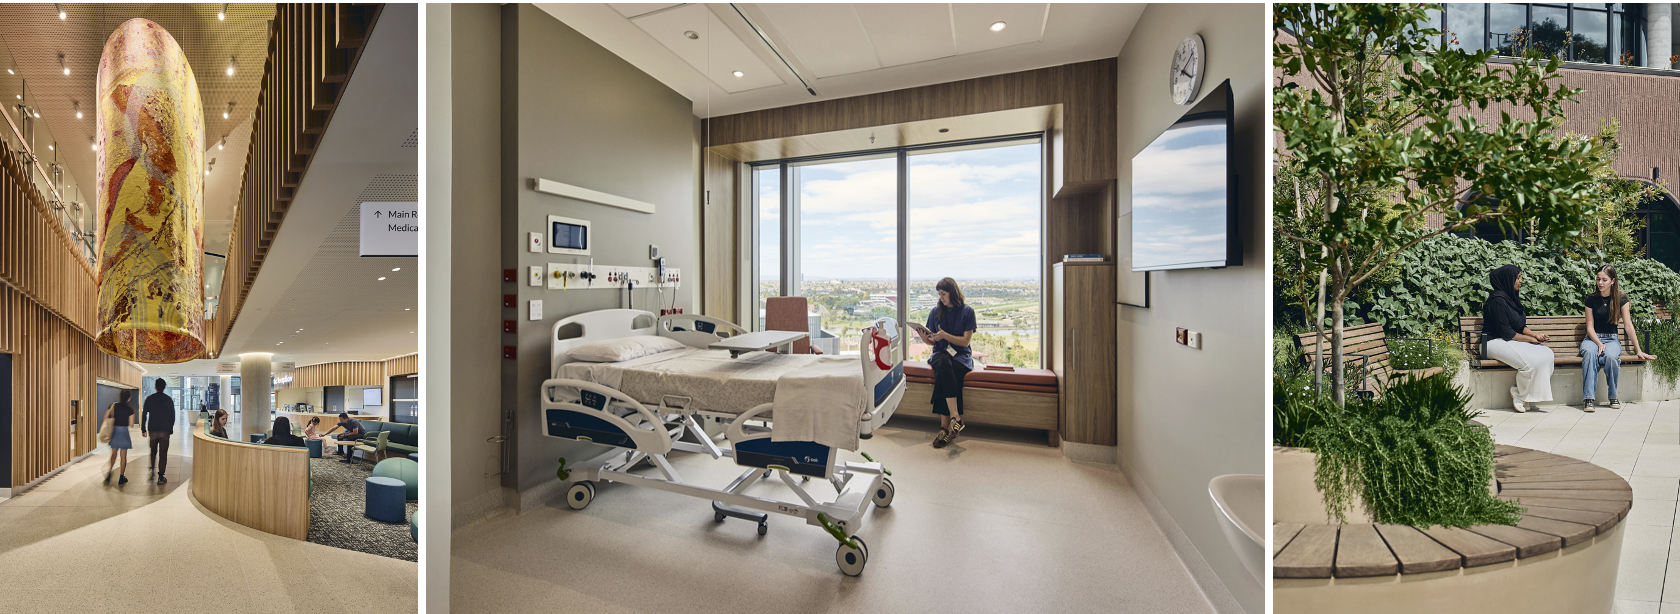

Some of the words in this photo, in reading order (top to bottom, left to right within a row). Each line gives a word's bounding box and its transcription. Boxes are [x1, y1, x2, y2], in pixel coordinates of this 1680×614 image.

[388, 210, 410, 219] Main
[411, 210, 418, 219] R
[388, 223, 418, 232] Medica
